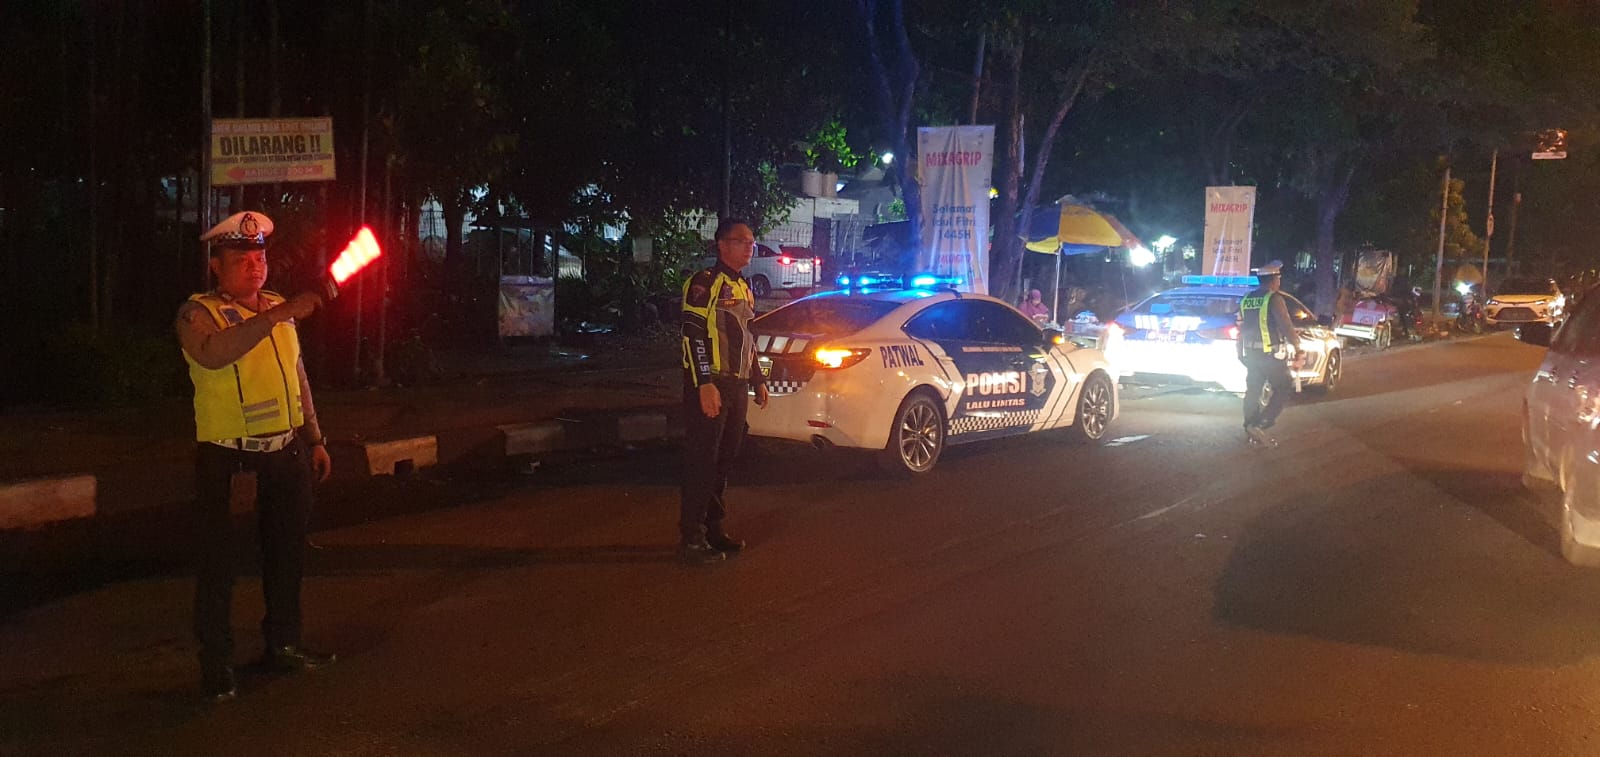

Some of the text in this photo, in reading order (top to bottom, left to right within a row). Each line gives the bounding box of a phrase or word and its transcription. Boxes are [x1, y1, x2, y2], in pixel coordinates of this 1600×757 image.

[220, 134, 321, 156] DILARANG !!
[925, 151, 982, 168] MIXAGRIP
[932, 203, 976, 214] Selamat
[1210, 202, 1248, 213] MIXAGRIP
[695, 339, 711, 376] POLISI
[879, 344, 924, 369] PATWAL
[966, 371, 1027, 396] POLISI
[966, 399, 1025, 410] LALU LINTAS
